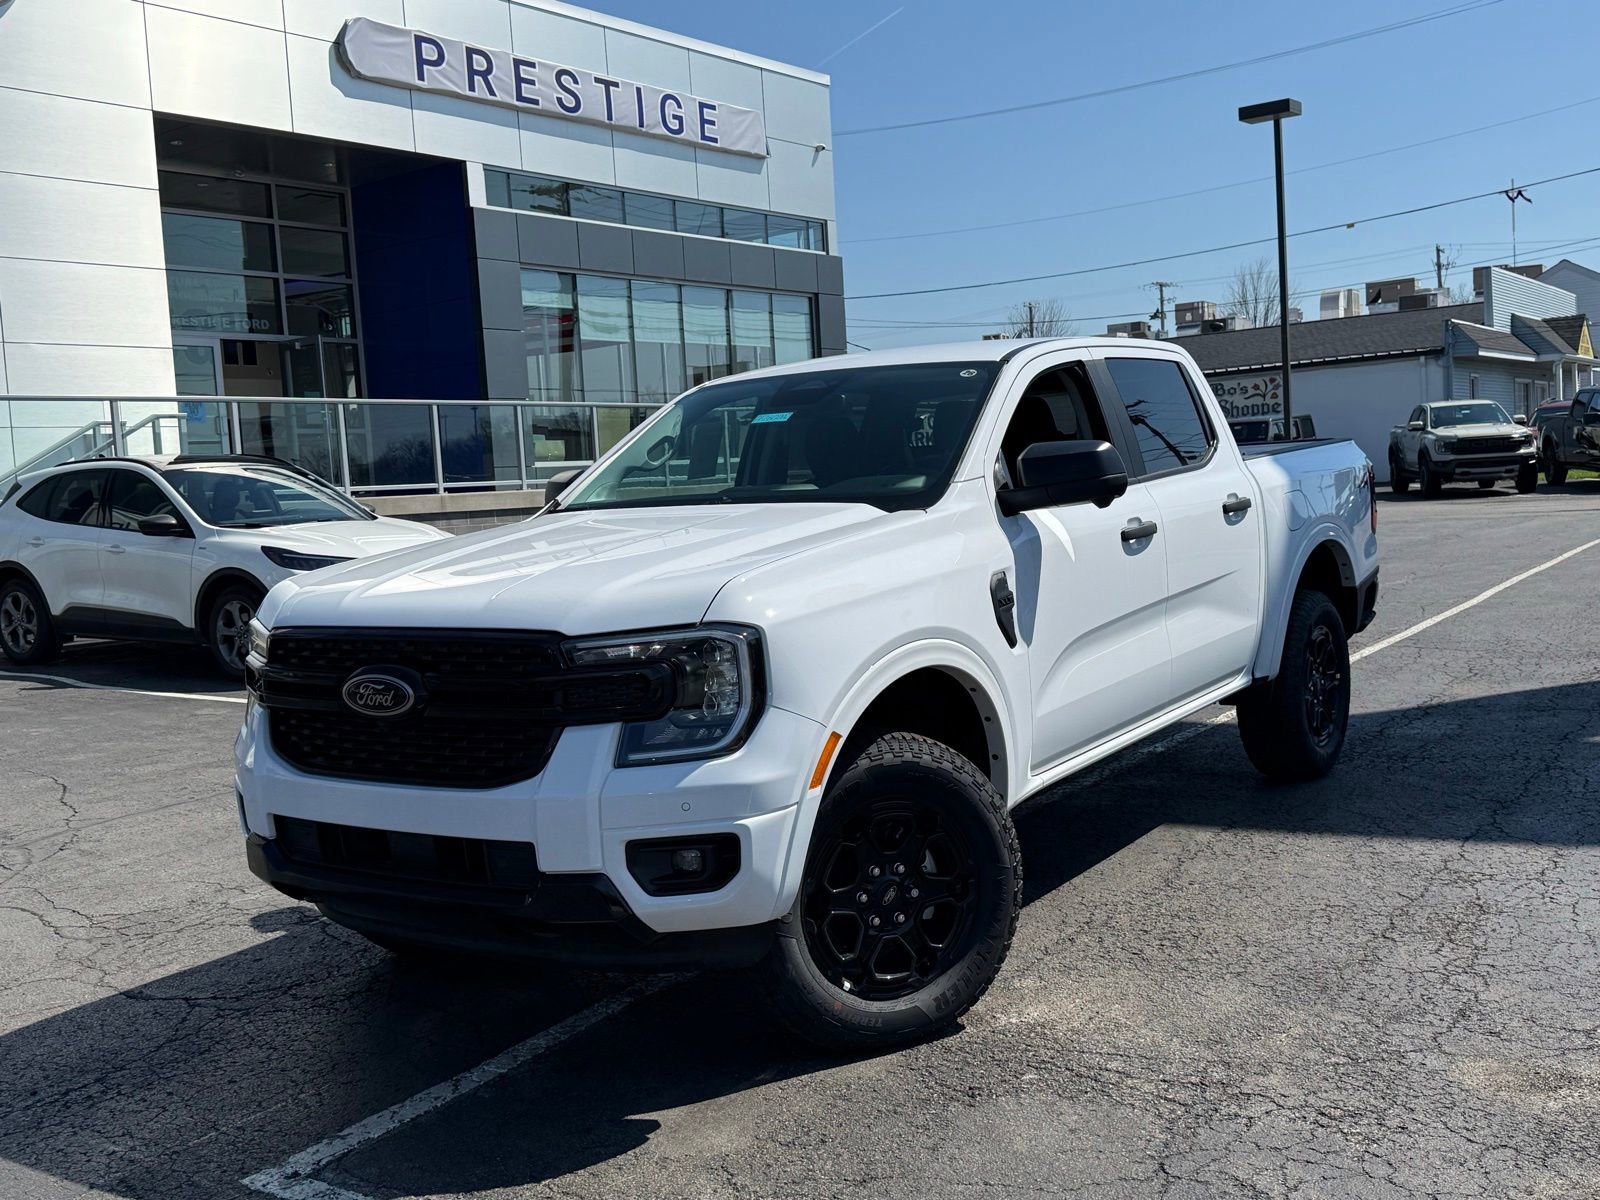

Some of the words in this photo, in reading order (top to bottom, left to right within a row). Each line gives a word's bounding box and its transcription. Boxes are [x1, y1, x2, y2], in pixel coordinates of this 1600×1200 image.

[413, 33, 720, 144] PRESTIGE
[234, 319, 270, 330] FORD
[1209, 382, 1249, 397] Bo's
[356, 682, 394, 706] Ford
